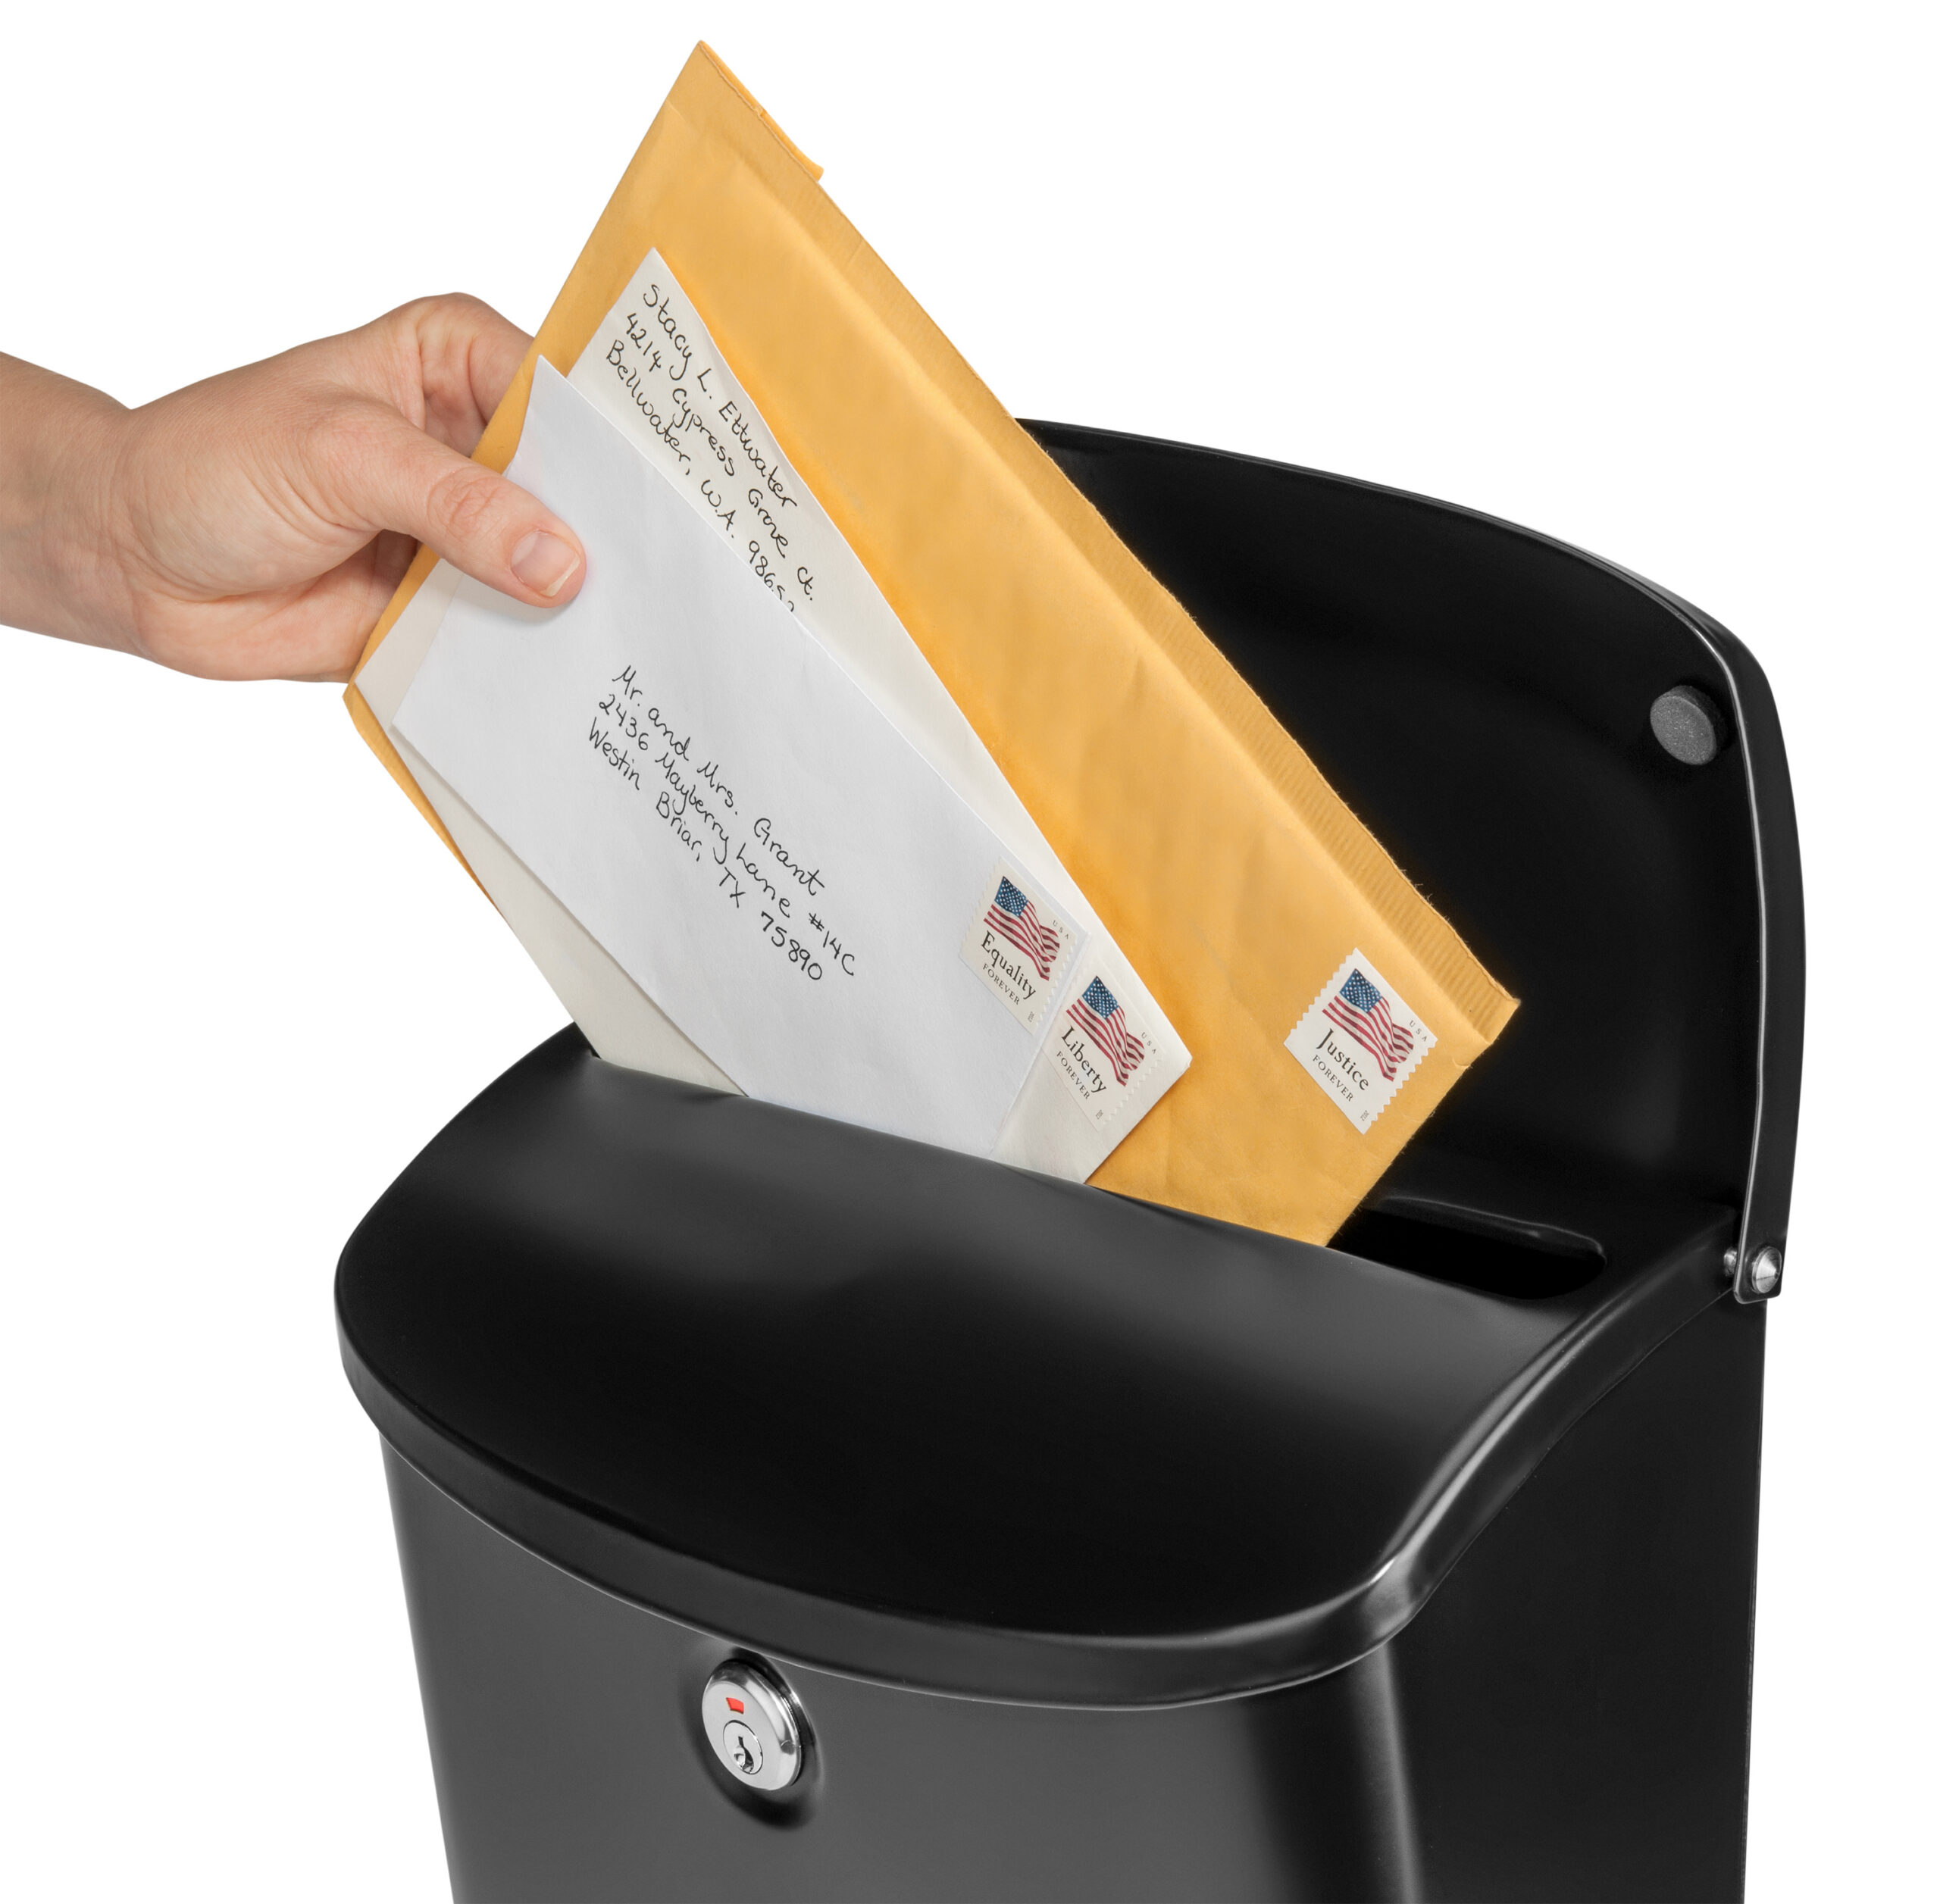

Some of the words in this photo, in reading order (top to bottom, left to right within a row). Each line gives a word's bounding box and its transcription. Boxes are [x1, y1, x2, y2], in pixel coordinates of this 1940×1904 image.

[643, 284, 692, 380] Stacy
[697, 368, 712, 400] L.
[718, 401, 797, 507] Ettwater
[606, 339, 691, 476] Bellwater,
[701, 480, 737, 539] W.A.
[626, 313, 661, 372] 4214
[672, 388, 734, 477] Cypress
[749, 489, 788, 558] Grove
[797, 567, 814, 602] Ct.
[612, 665, 643, 707] Mr.
[648, 708, 690, 761] and
[696, 761, 738, 816] Mrs.
[754, 818, 824, 896] Grant
[590, 717, 640, 790] Westin
[656, 792, 702, 861] Briar,
[719, 867, 746, 908] TX
[761, 911, 822, 980] 75890
[599, 694, 649, 750] 2436
[655, 752, 729, 864] Mayberry
[736, 843, 790, 918] Lane
[809, 913, 855, 976] #14C
[1053, 920, 1069, 939] USA
[981, 930, 1036, 1000] Equality
[983, 963, 1020, 1005] FOREVER
[1061, 1026, 1106, 1093] Liberty
[1141, 1032, 1156, 1054] USA
[1316, 1028, 1369, 1090] Justice
[1409, 1020, 1428, 1042] USA
[1056, 1051, 1090, 1099] FOREVER
[1313, 1055, 1354, 1102] FOREVER
